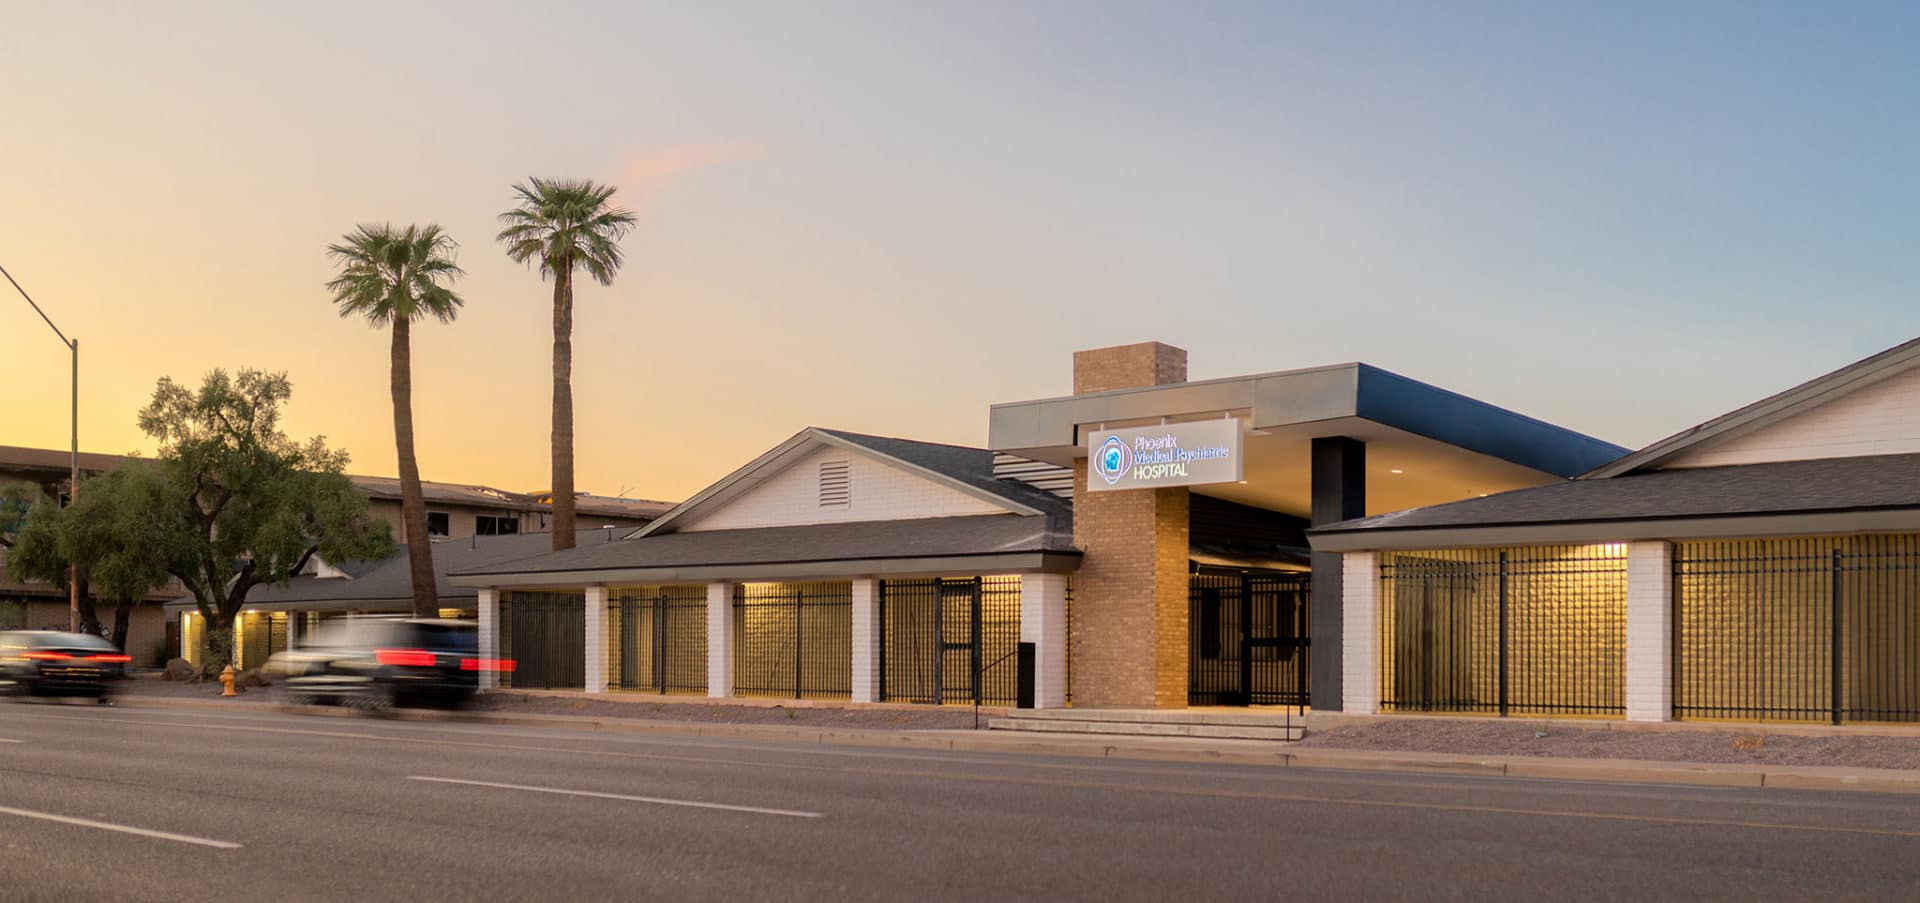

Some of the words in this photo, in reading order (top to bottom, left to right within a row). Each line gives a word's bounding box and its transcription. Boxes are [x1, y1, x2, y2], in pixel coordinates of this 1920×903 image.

[1135, 434, 1177, 450] Phoenix
[1134, 448, 1173, 464] Medical
[1134, 463, 1188, 480] HOSPITAL
